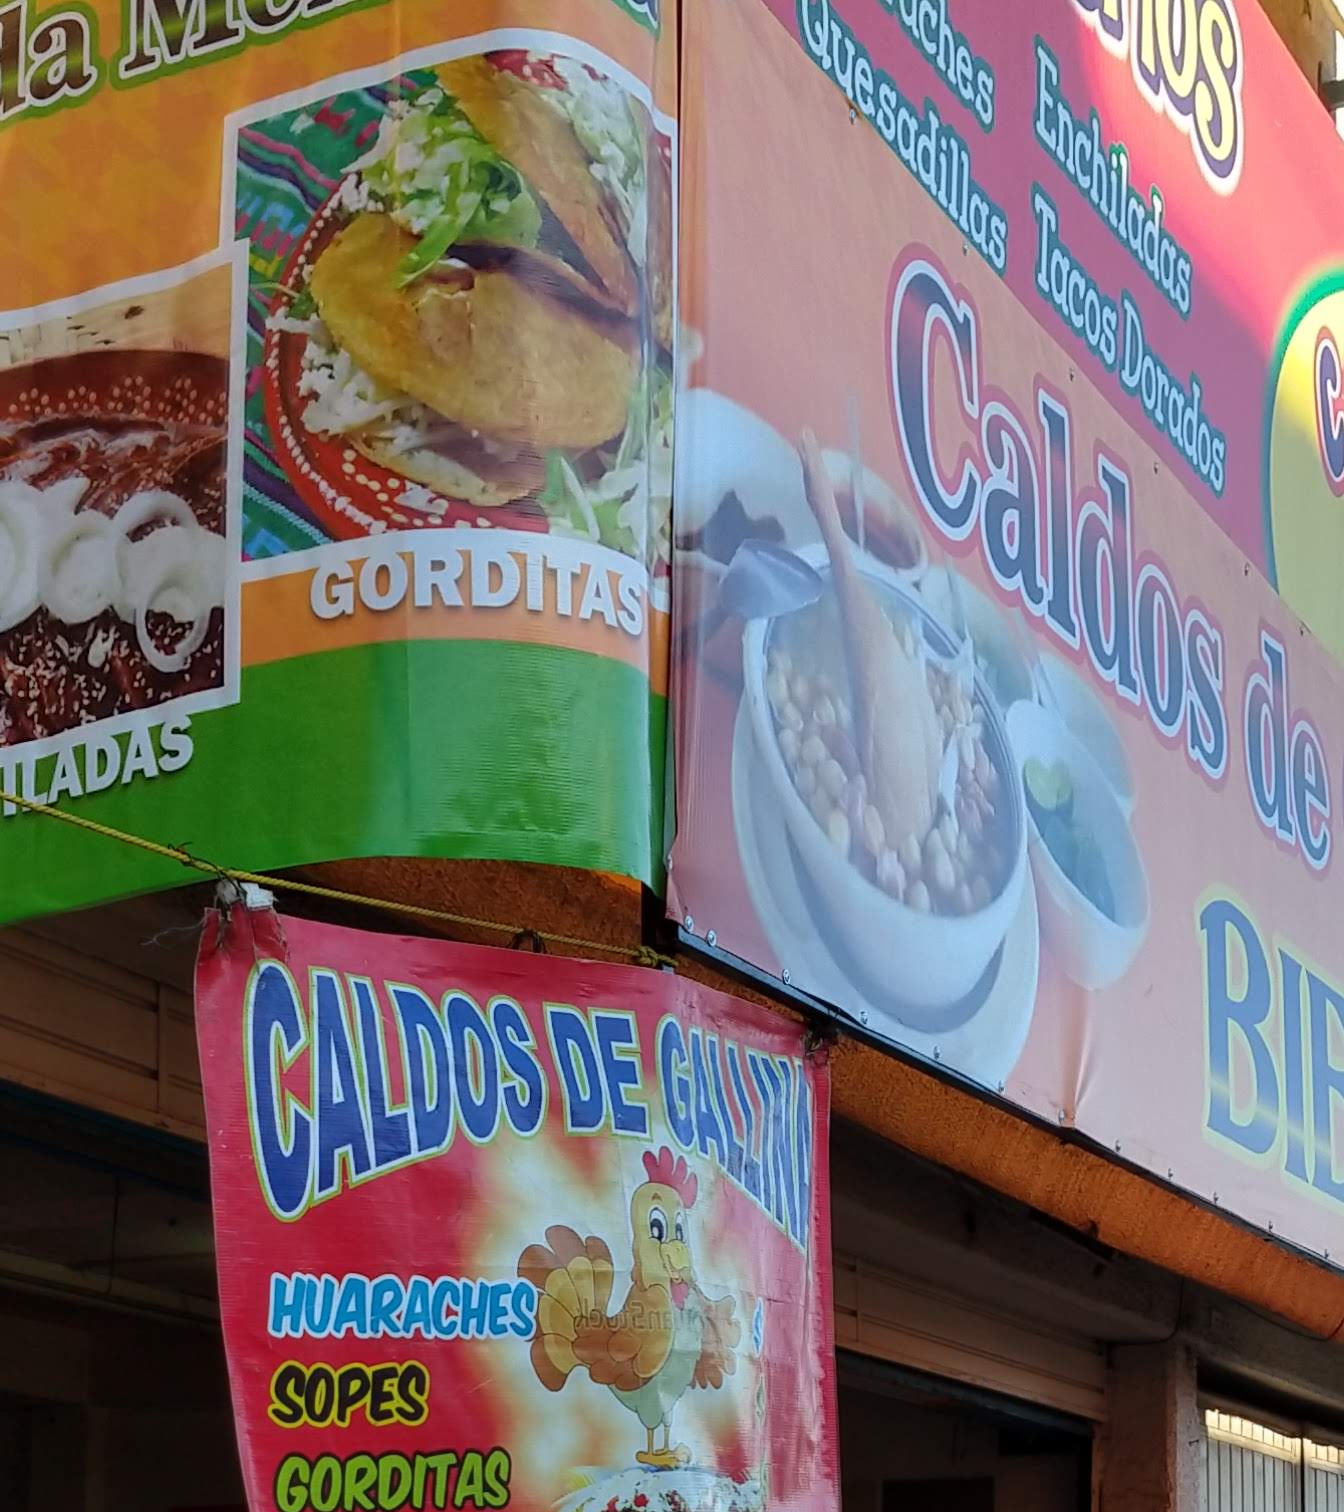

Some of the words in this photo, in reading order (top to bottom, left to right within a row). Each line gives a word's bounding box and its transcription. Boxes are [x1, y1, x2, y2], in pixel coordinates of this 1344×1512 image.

[801, 0, 1007, 269] Quesadillas
[884, 0, 994, 125] aches
[1035, 46, 1192, 313] Enchiladas
[1034, 191, 1118, 365] Tacos
[1122, 298, 1226, 492] Dorados
[310, 552, 645, 636] GORDITAS
[892, 258, 1227, 780] Caldos
[1246, 630, 1332, 870] de
[247, 960, 548, 1220] CALDOS
[545, 1002, 653, 1140] DE
[267, 1272, 536, 1340] HUARACHES
[268, 1361, 429, 1428] SOPES
